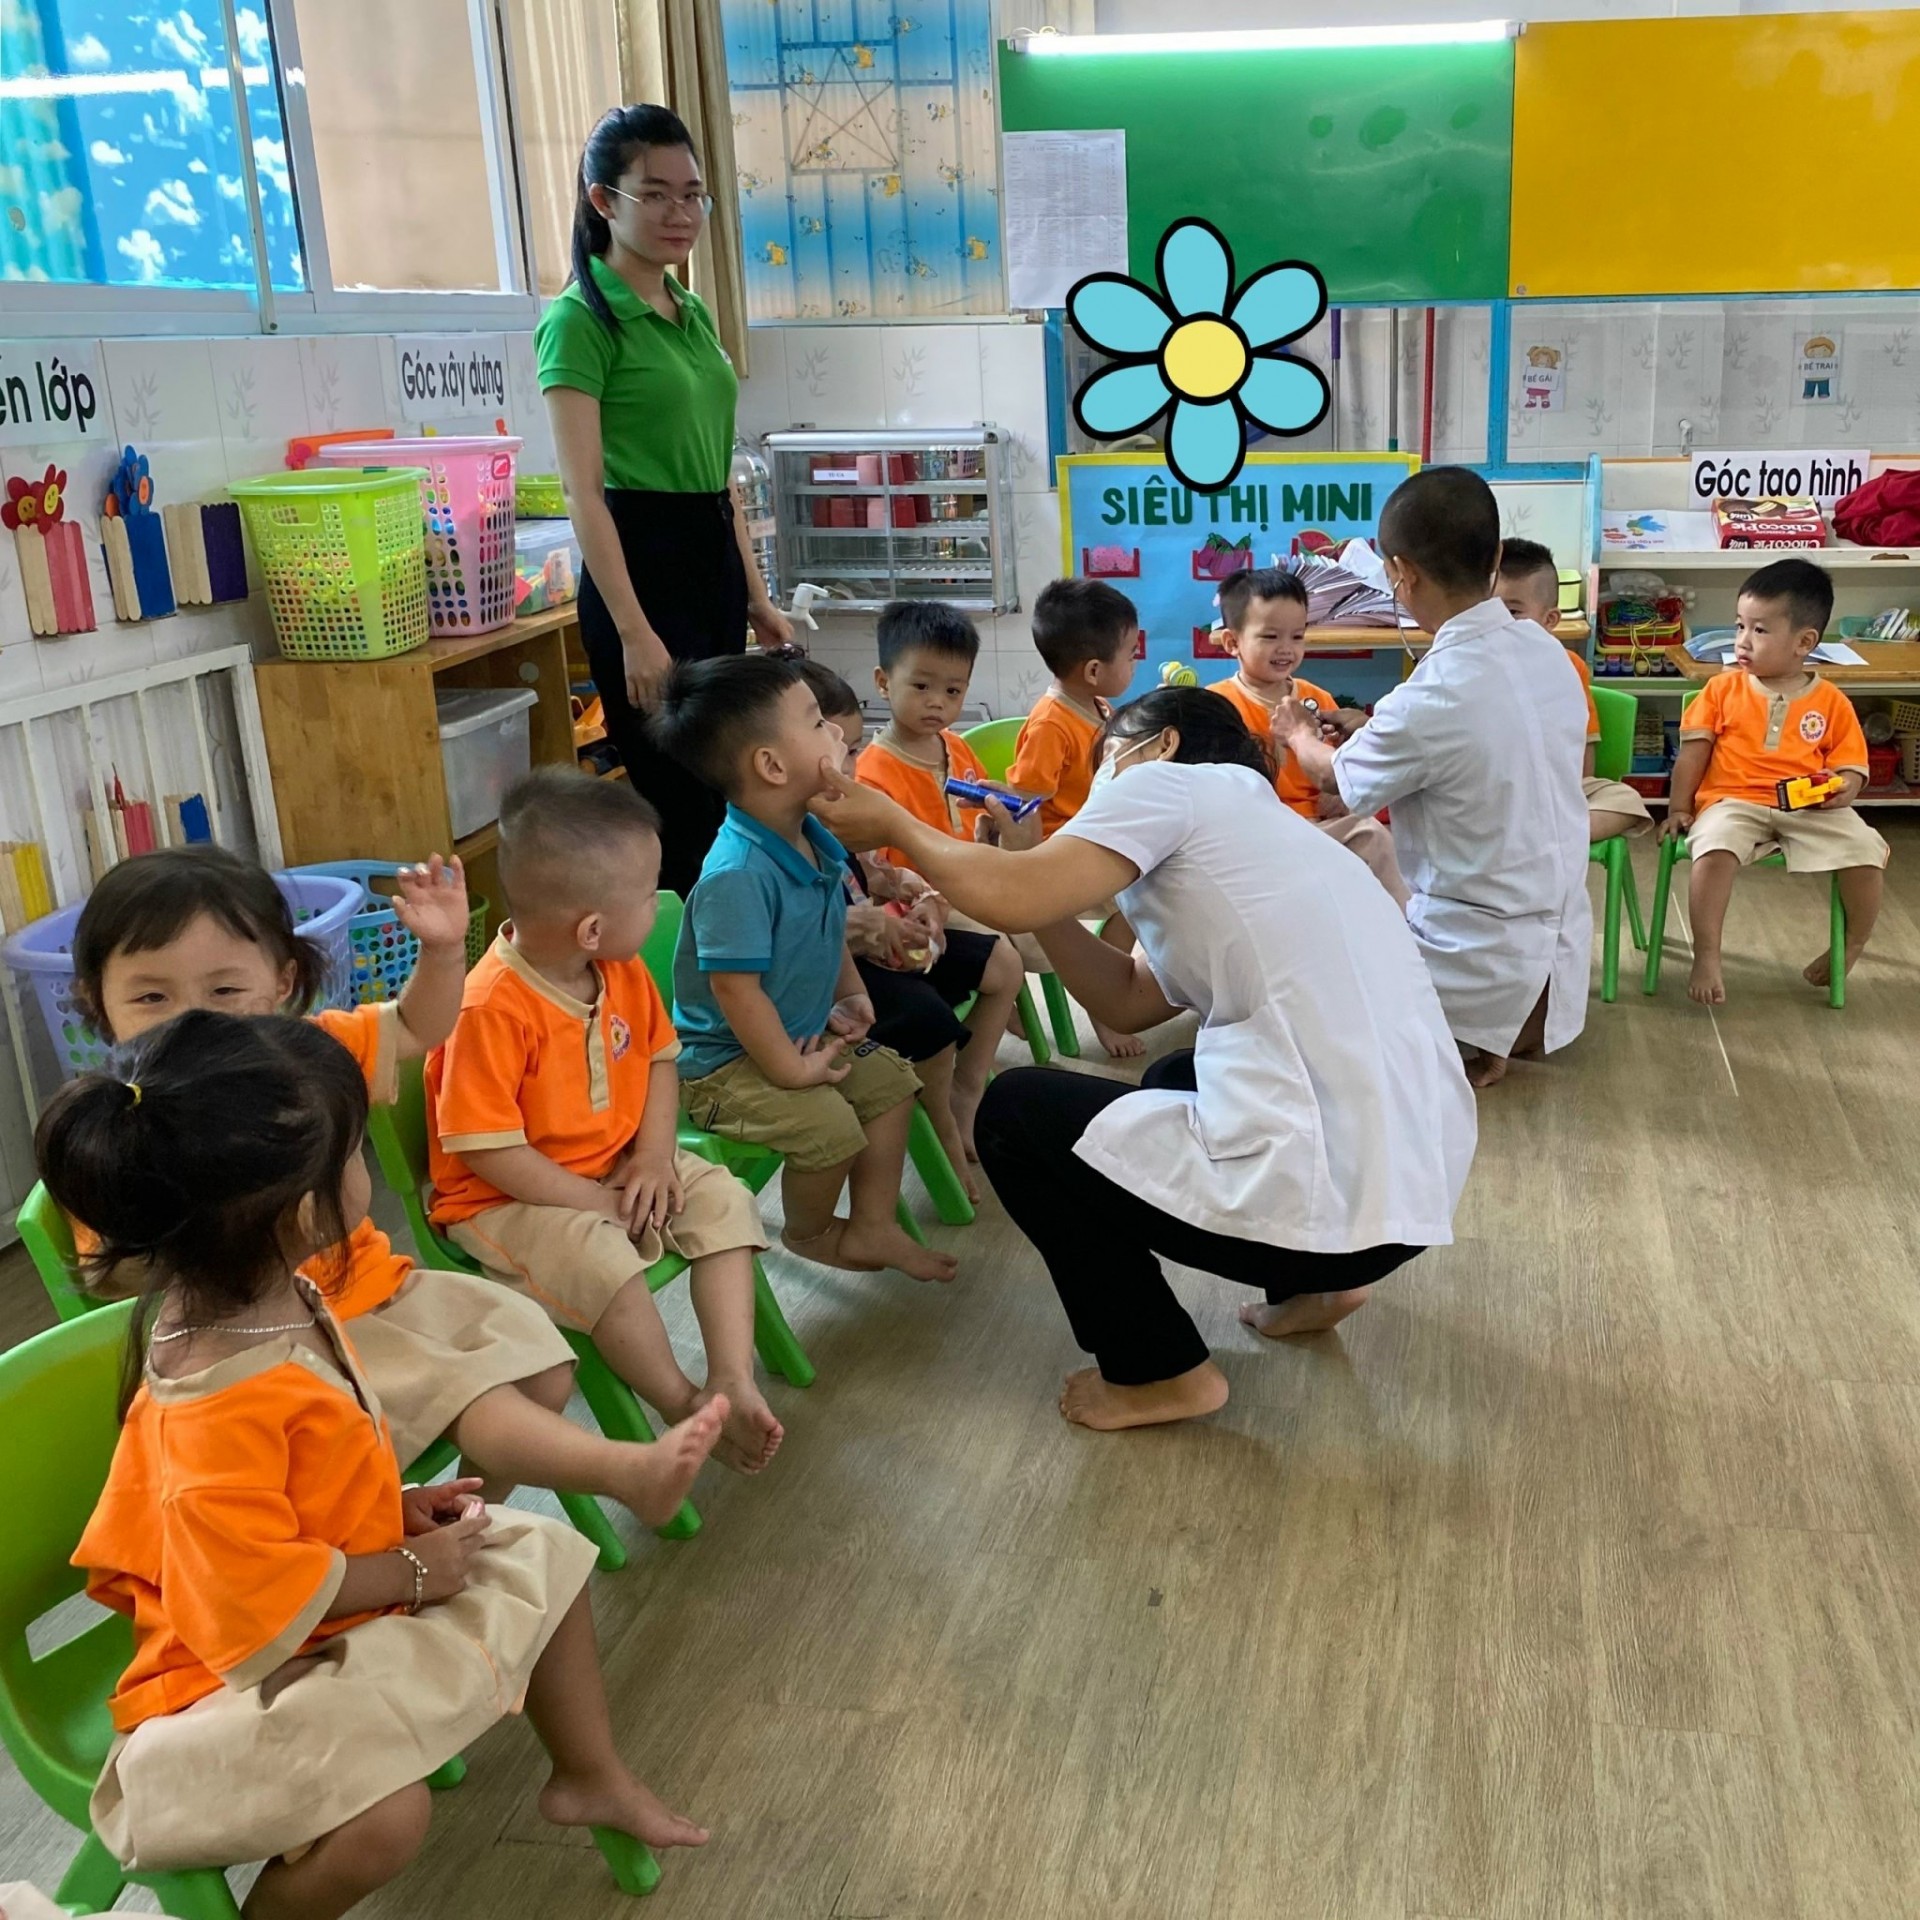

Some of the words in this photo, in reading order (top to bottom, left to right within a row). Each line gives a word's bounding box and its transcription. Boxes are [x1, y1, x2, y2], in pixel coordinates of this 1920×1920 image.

[402, 349, 436, 400] Góc
[439, 350, 465, 407] xây
[469, 350, 504, 406] dựng
[1527, 373, 1537, 383] BÉ
[1803, 361, 1814, 371] BÉ
[1815, 361, 1834, 370] TRAI
[35, 356, 96, 433] lớp
[1695, 458, 1751, 497] Góc
[1809, 458, 1862, 496] hình
[1101, 474, 1193, 526] SIÊU
[1199, 484, 1269, 532] THỊ
[1282, 483, 1372, 523] MINI
